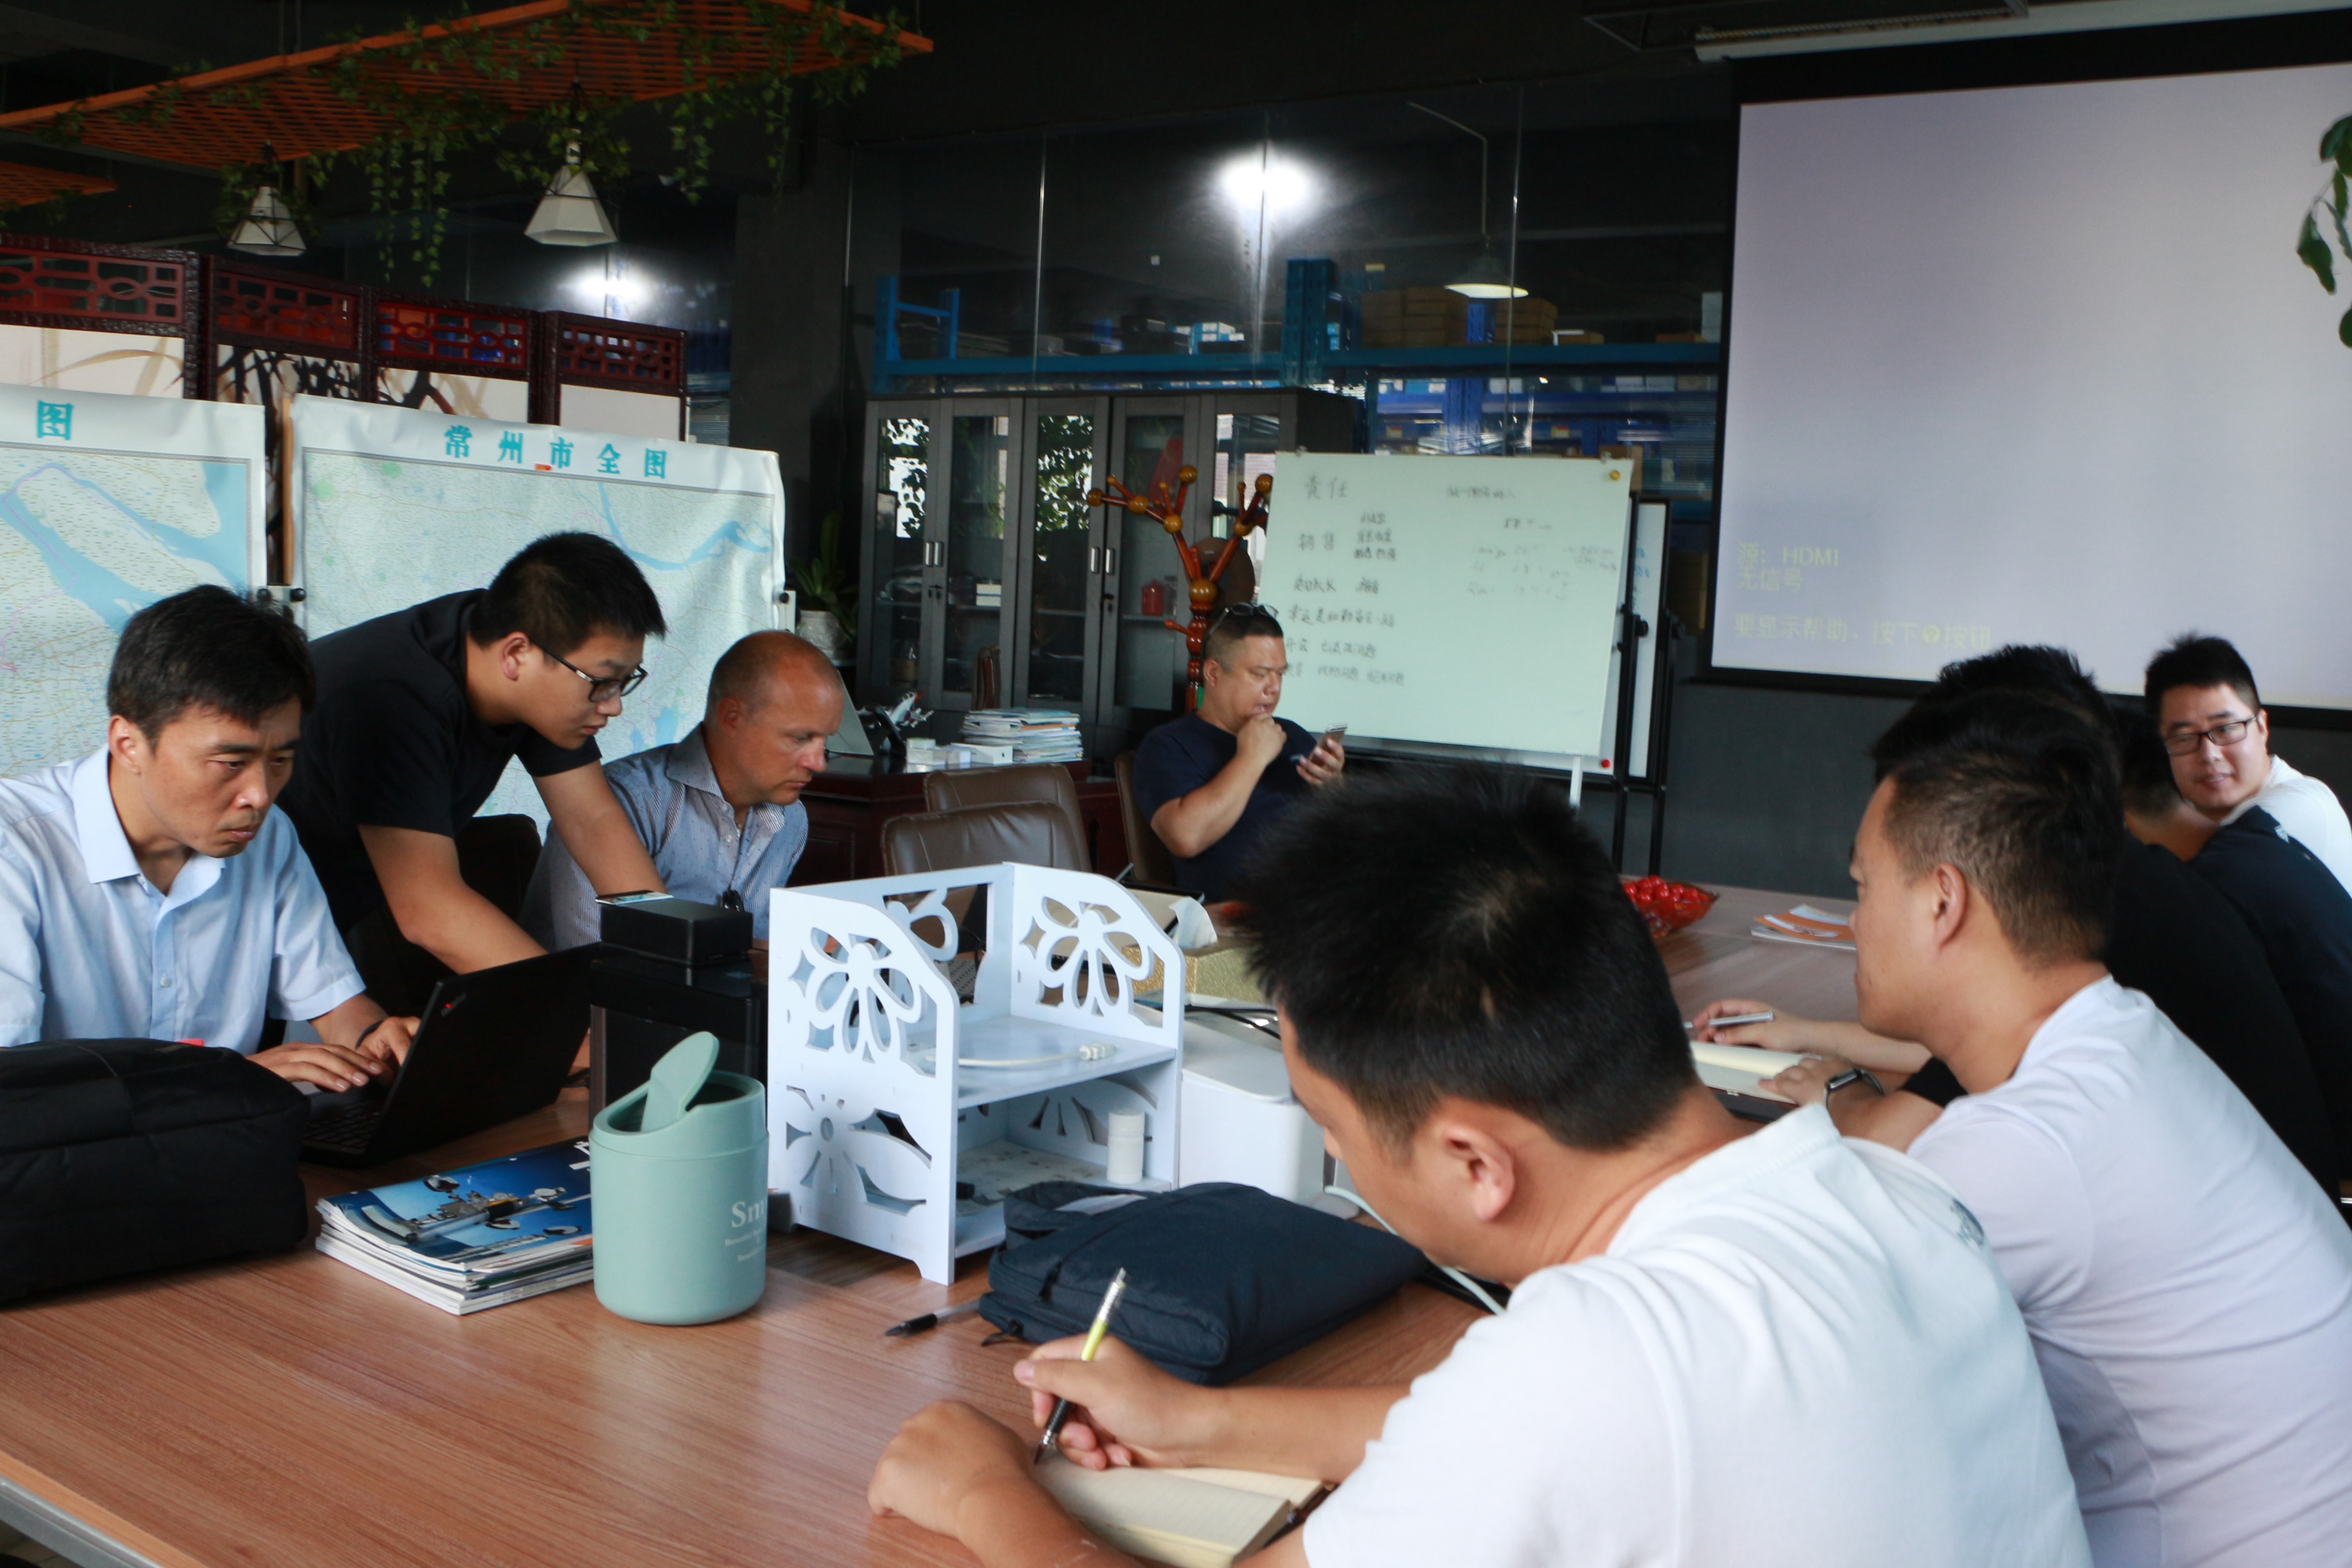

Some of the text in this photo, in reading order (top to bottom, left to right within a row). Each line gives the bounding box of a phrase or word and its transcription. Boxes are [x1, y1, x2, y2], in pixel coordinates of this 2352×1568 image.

[36, 400, 73, 441] 图
[445, 425, 667, 479] 常州市全图
[1783, 546, 1840, 567] HDMI
[1737, 566, 1803, 593] 无信号
